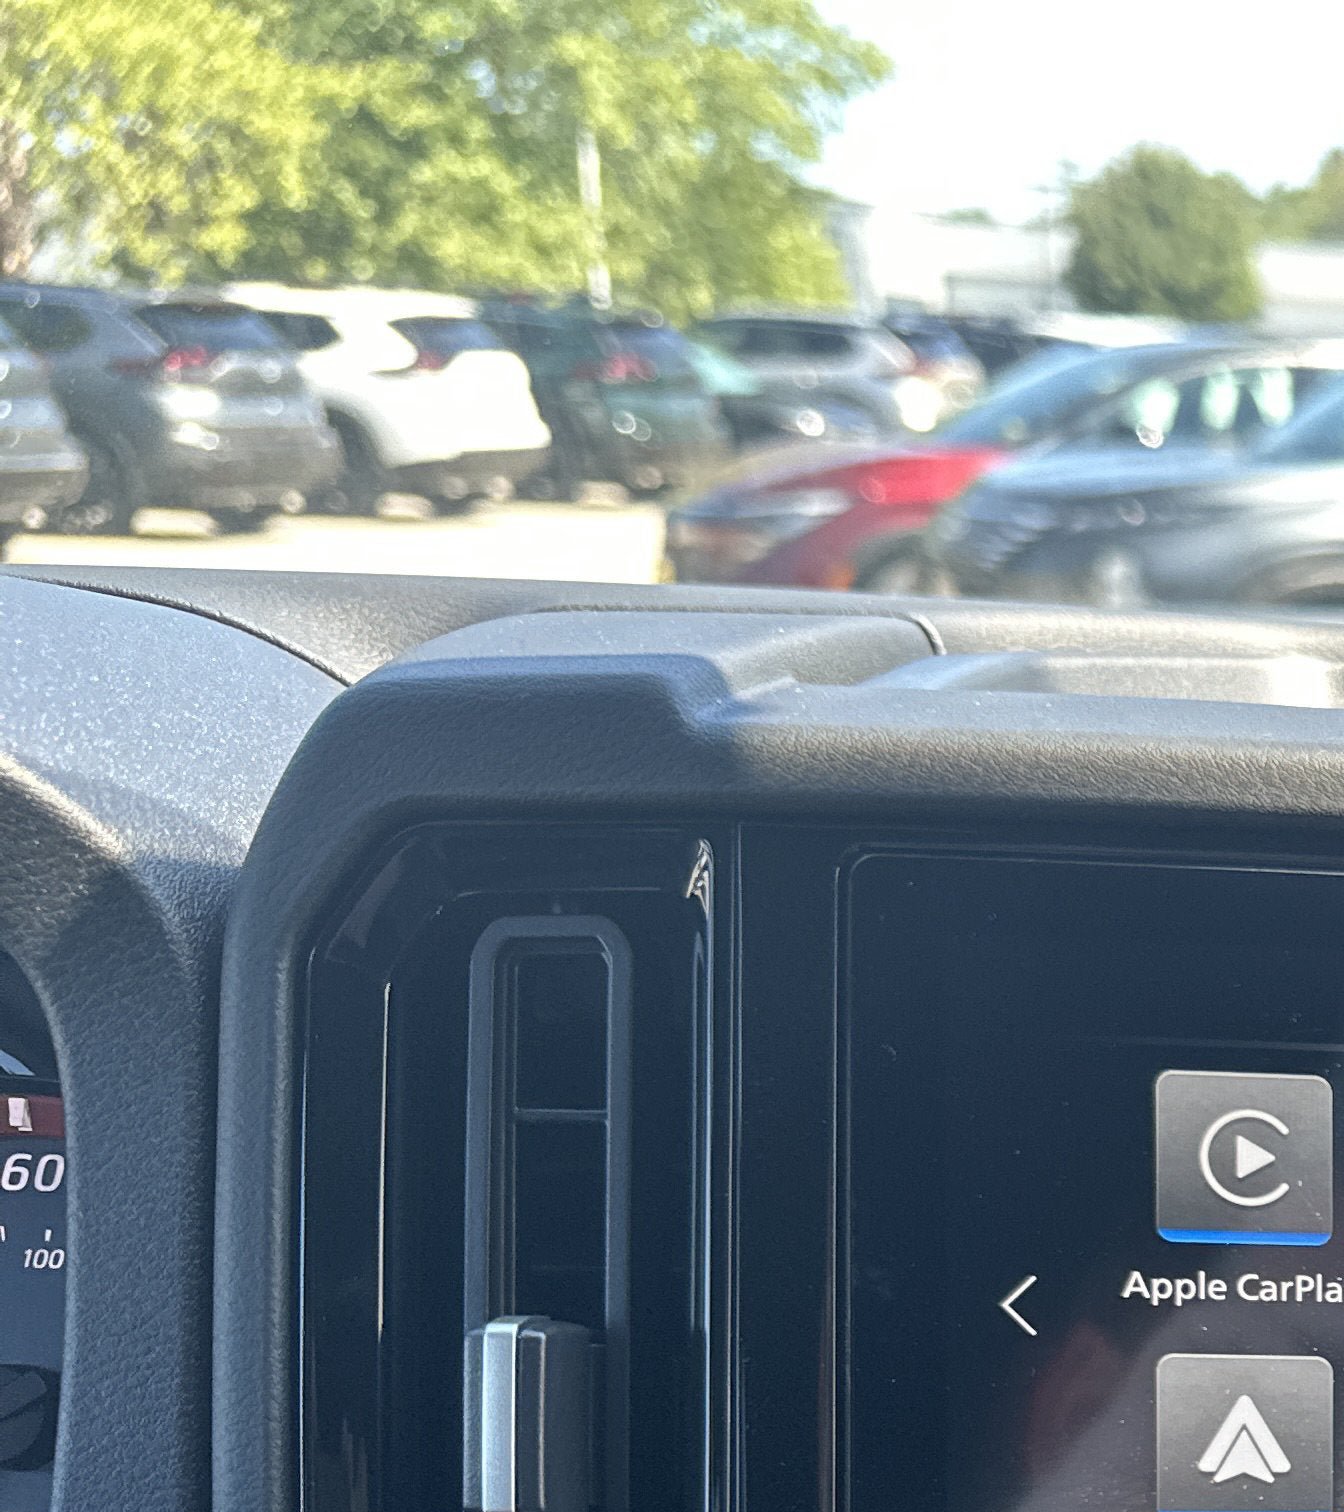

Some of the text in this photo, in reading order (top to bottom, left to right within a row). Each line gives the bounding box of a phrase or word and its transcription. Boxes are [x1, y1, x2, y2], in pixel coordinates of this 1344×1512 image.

[1, 1152, 65, 1192] 60
[23, 1248, 65, 1270] 100
[1121, 1269, 1228, 1306] Apple
